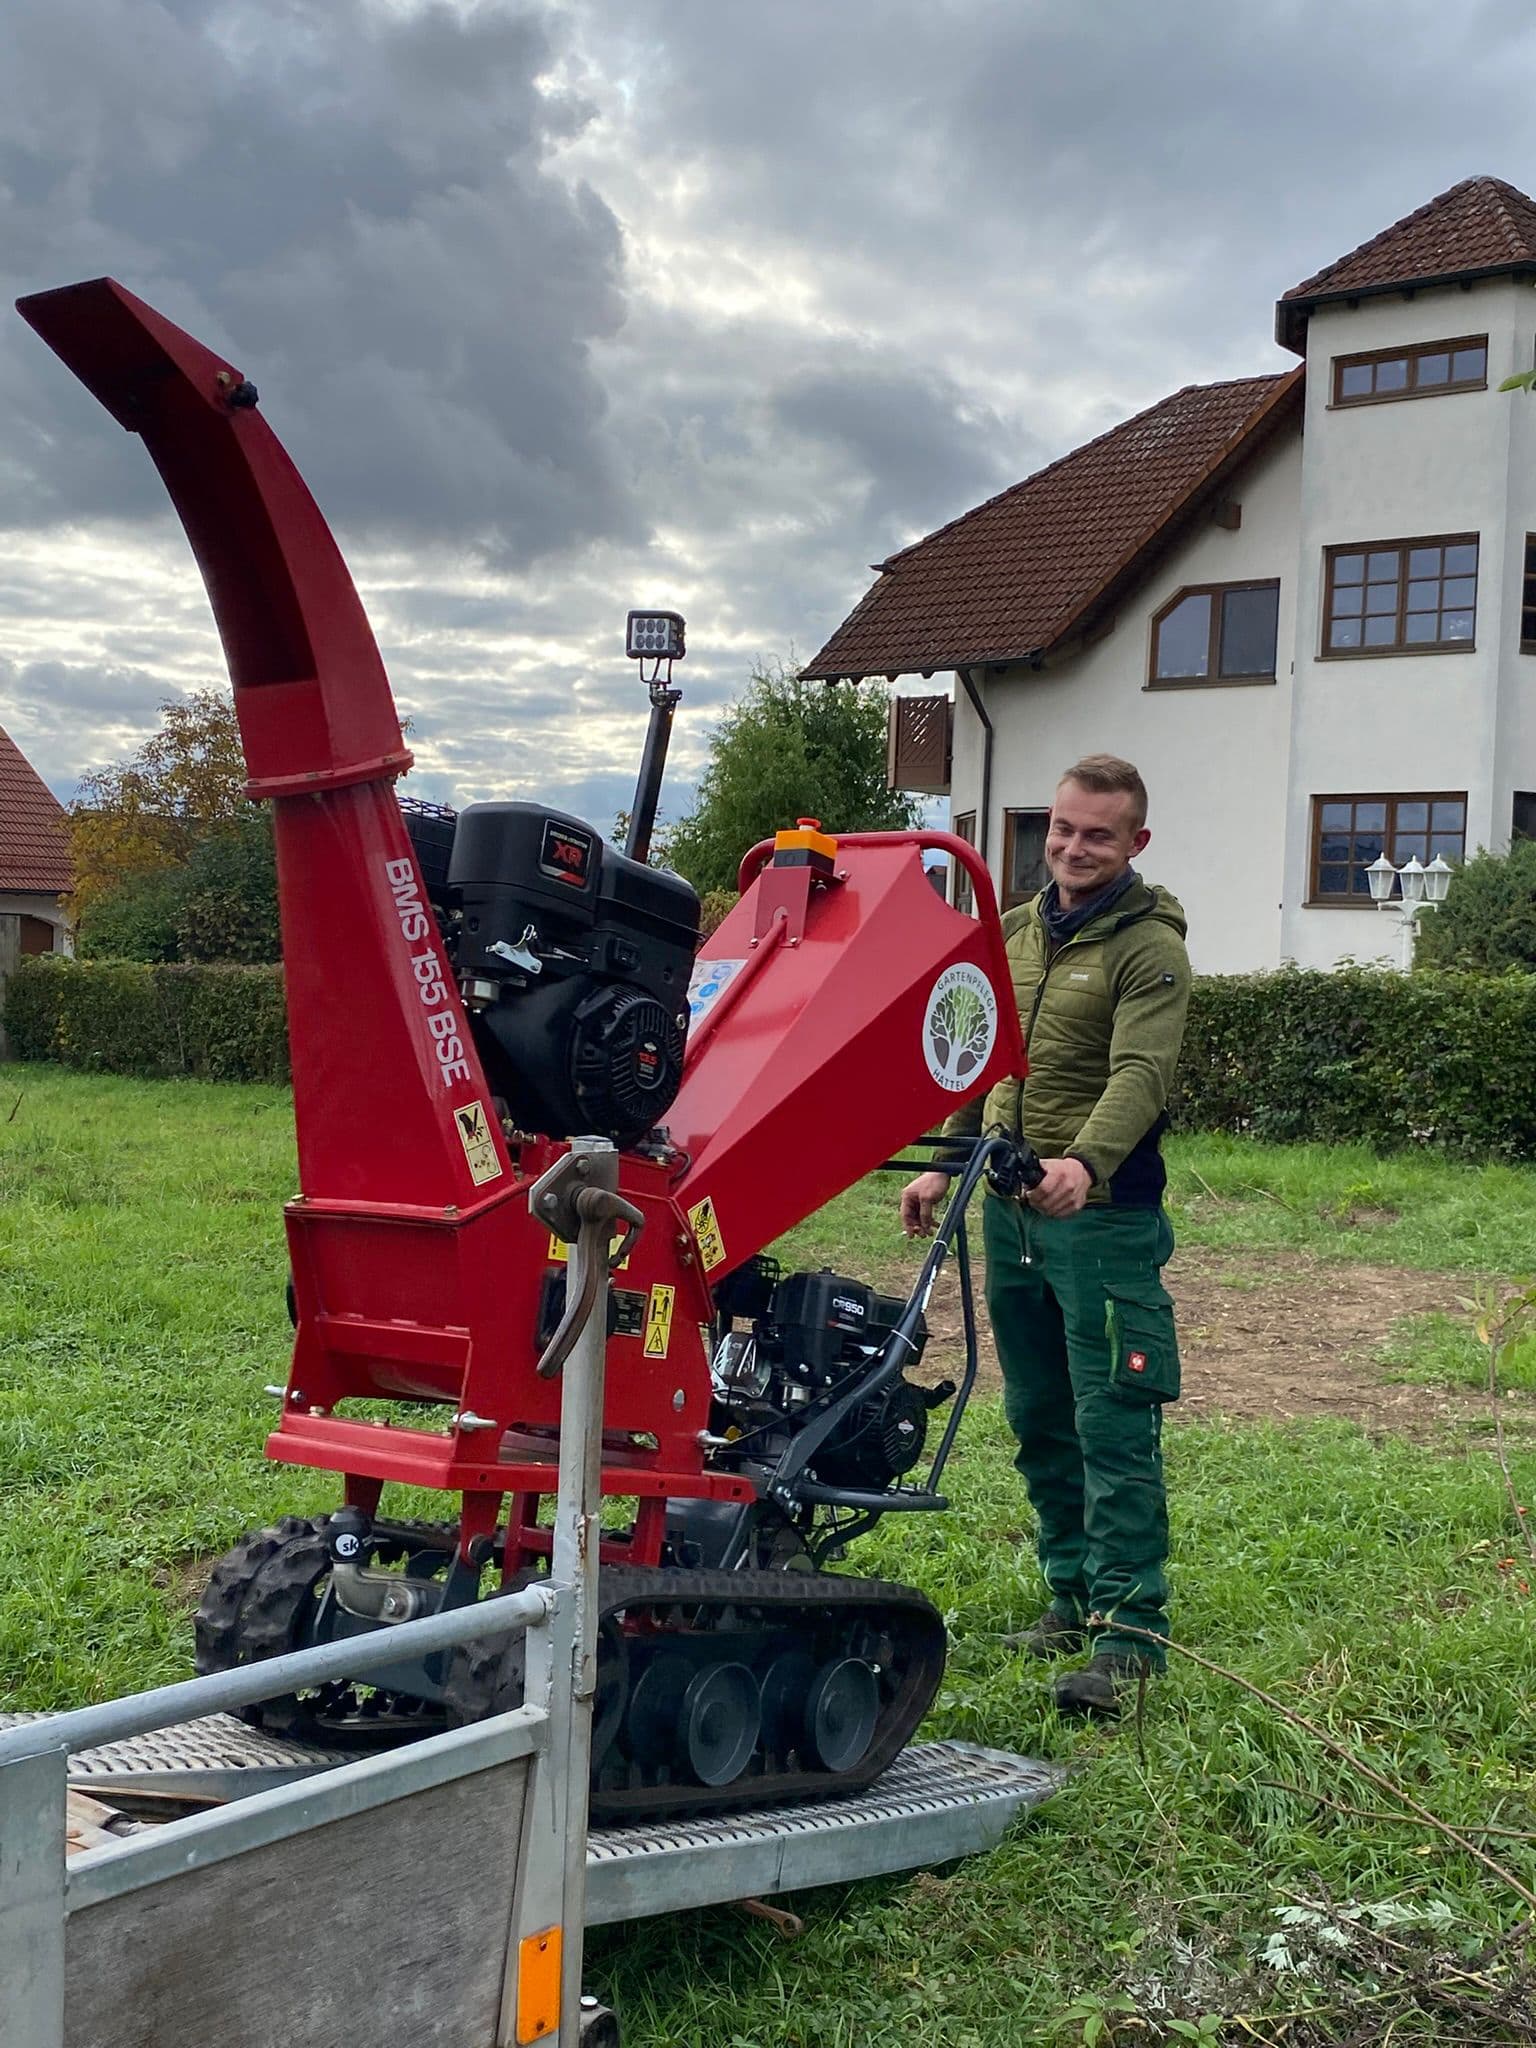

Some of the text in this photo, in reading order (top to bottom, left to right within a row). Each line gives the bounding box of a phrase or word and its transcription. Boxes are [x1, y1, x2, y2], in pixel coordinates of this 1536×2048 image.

[385, 857, 472, 1088] BMS 155 BSE
[937, 971, 996, 1014] GARTENPFLEGE
[933, 1068, 966, 1091] HATTEL
